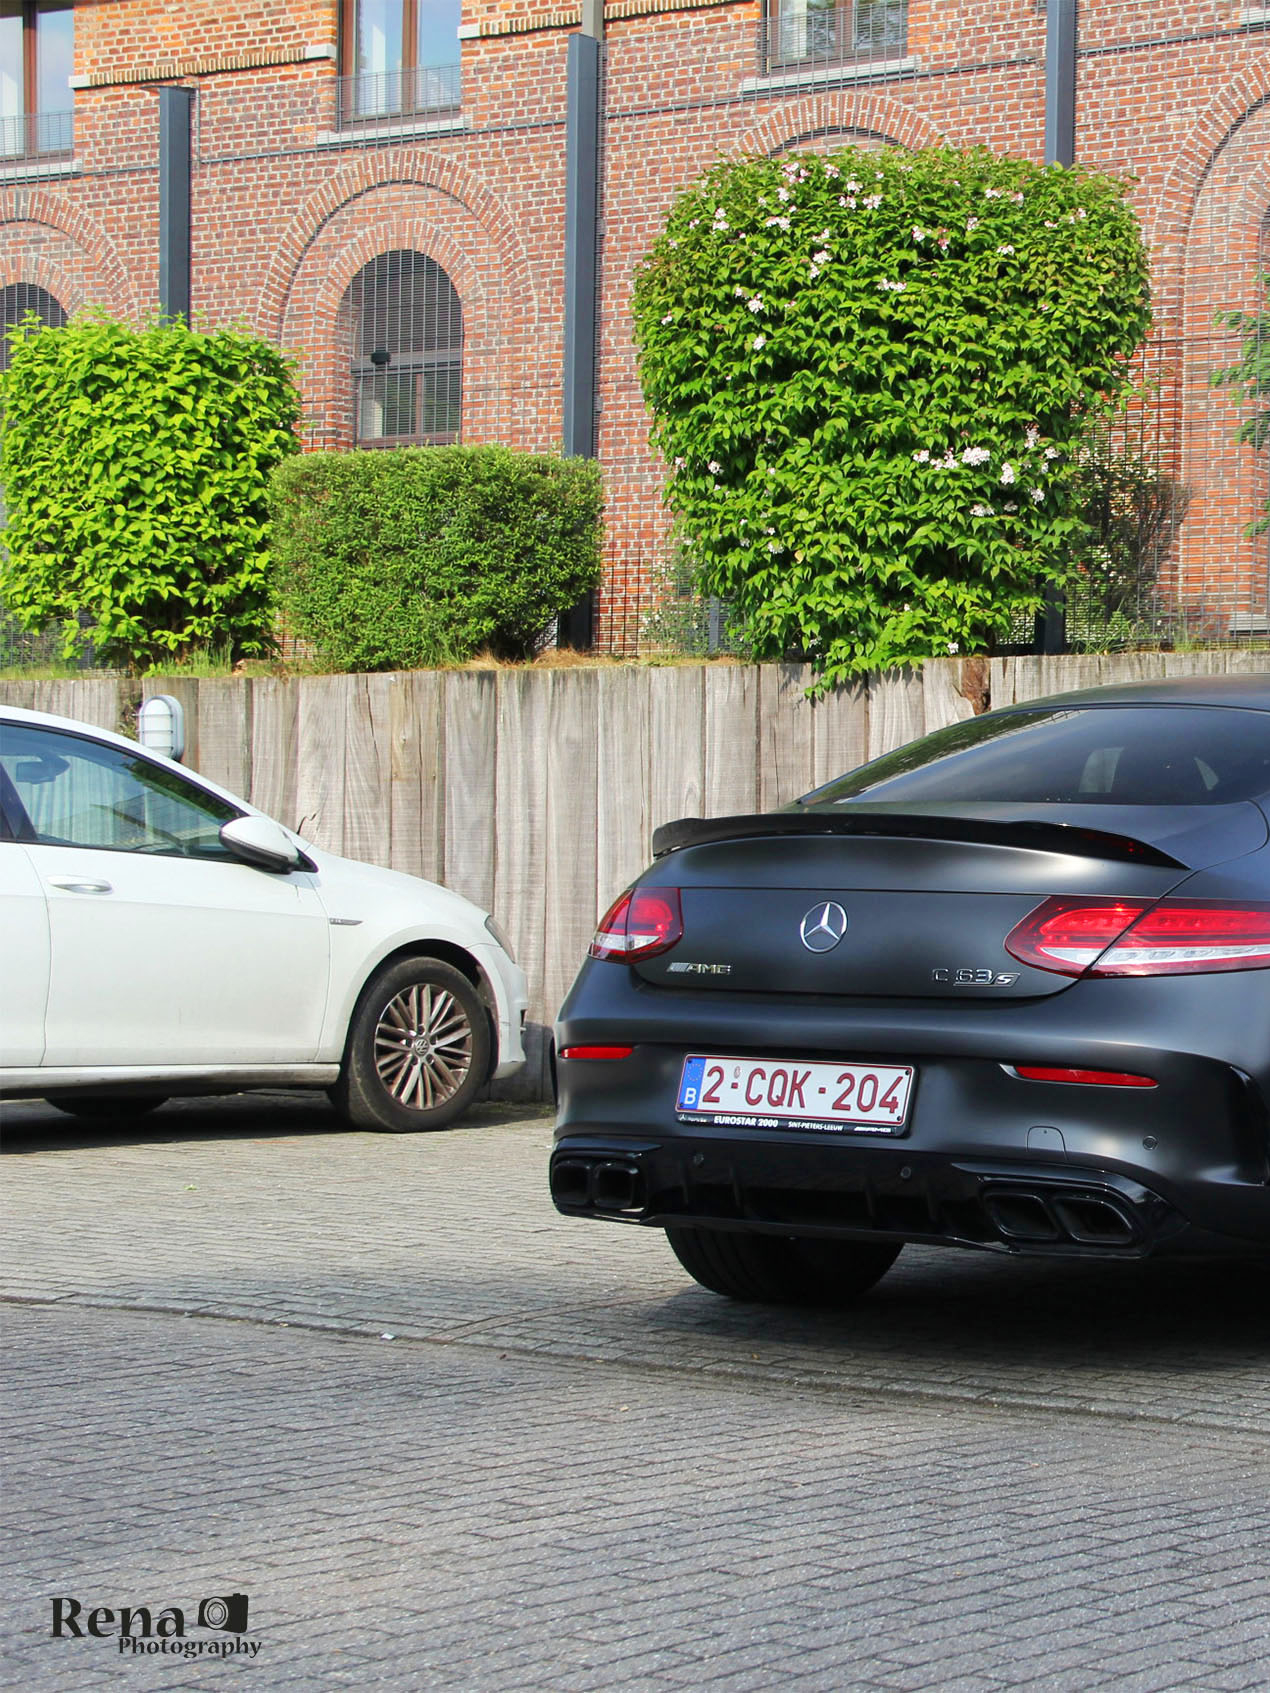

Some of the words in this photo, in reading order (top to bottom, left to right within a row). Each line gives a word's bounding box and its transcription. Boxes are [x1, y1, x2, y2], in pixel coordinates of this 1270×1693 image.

[686, 962, 732, 976] AMG
[932, 968, 949, 982] C
[683, 1087, 697, 1105] B
[713, 1115, 757, 1126] EUROSTAR
[758, 1118, 779, 1128] 2000
[787, 1121, 844, 1132] SINT-PIETERS-LEEUW
